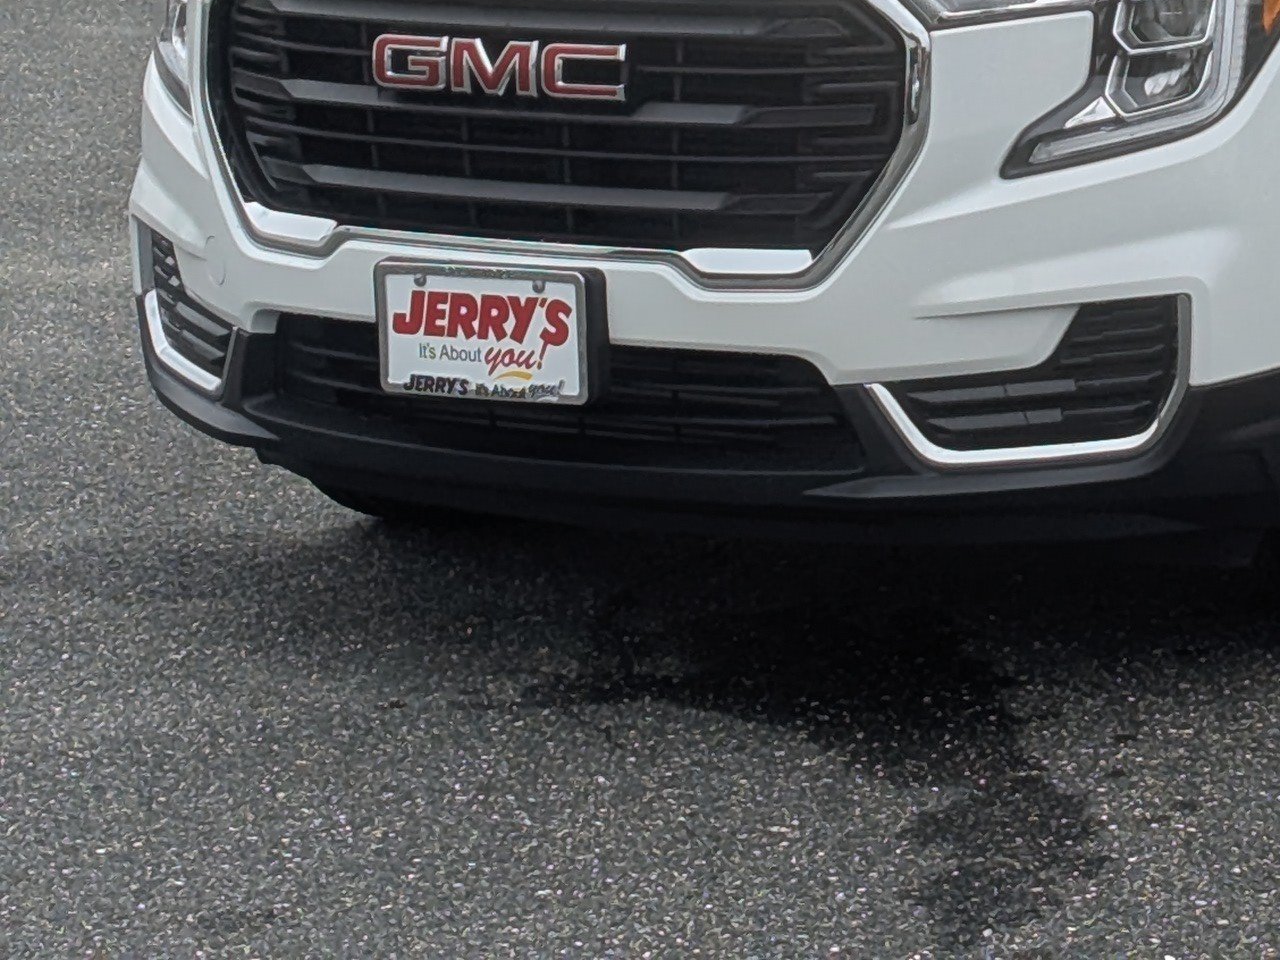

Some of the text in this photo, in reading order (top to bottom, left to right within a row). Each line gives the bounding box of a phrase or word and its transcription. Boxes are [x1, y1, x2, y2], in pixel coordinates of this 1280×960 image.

[372, 33, 627, 101] GMC
[392, 290, 573, 347] JERRY'S
[419, 341, 549, 376] It's About you!
[403, 373, 470, 395] JERRY'S
